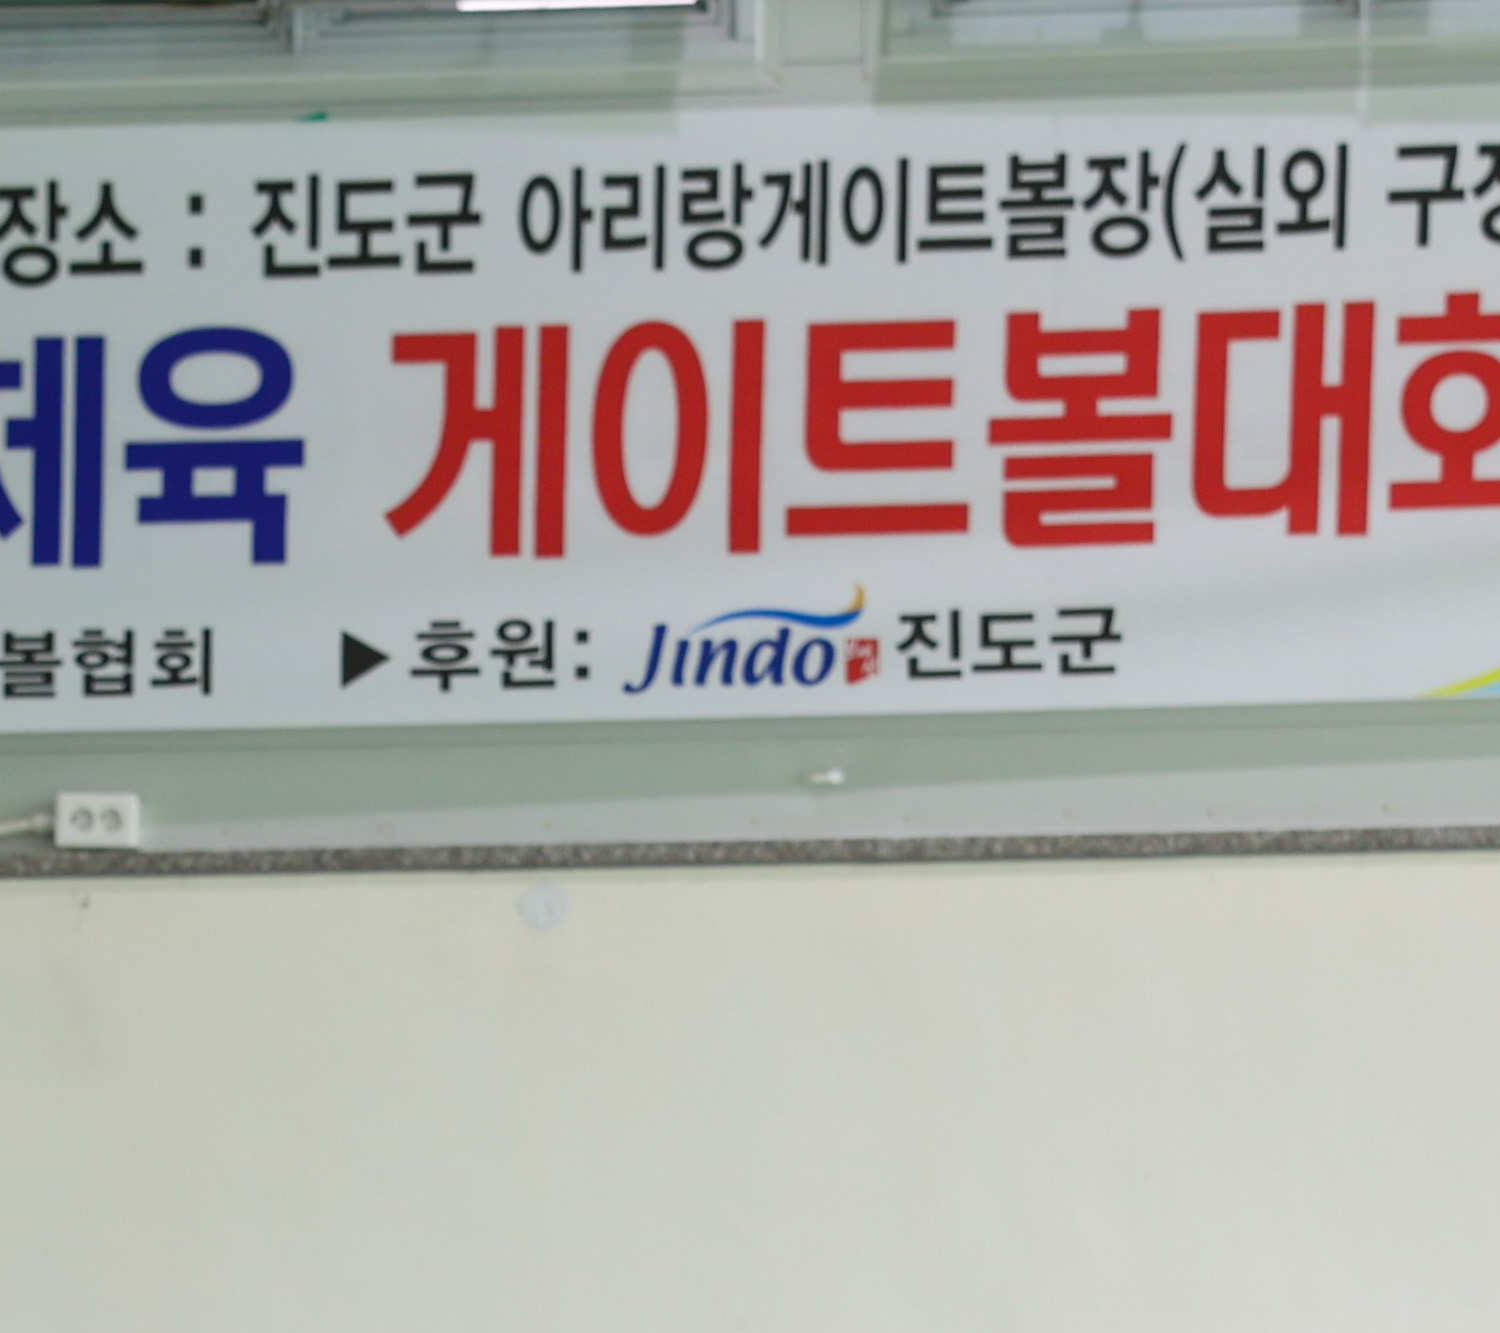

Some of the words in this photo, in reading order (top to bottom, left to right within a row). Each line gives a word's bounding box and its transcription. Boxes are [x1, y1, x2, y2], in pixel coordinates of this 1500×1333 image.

[252, 173, 482, 278] 진도군
[519, 143, 1349, 272] 아리랑게이트볼장(실외
[410, 620, 590, 691] 후원:
[623, 622, 836, 694] Jindo
[896, 606, 1122, 680] 진도군
